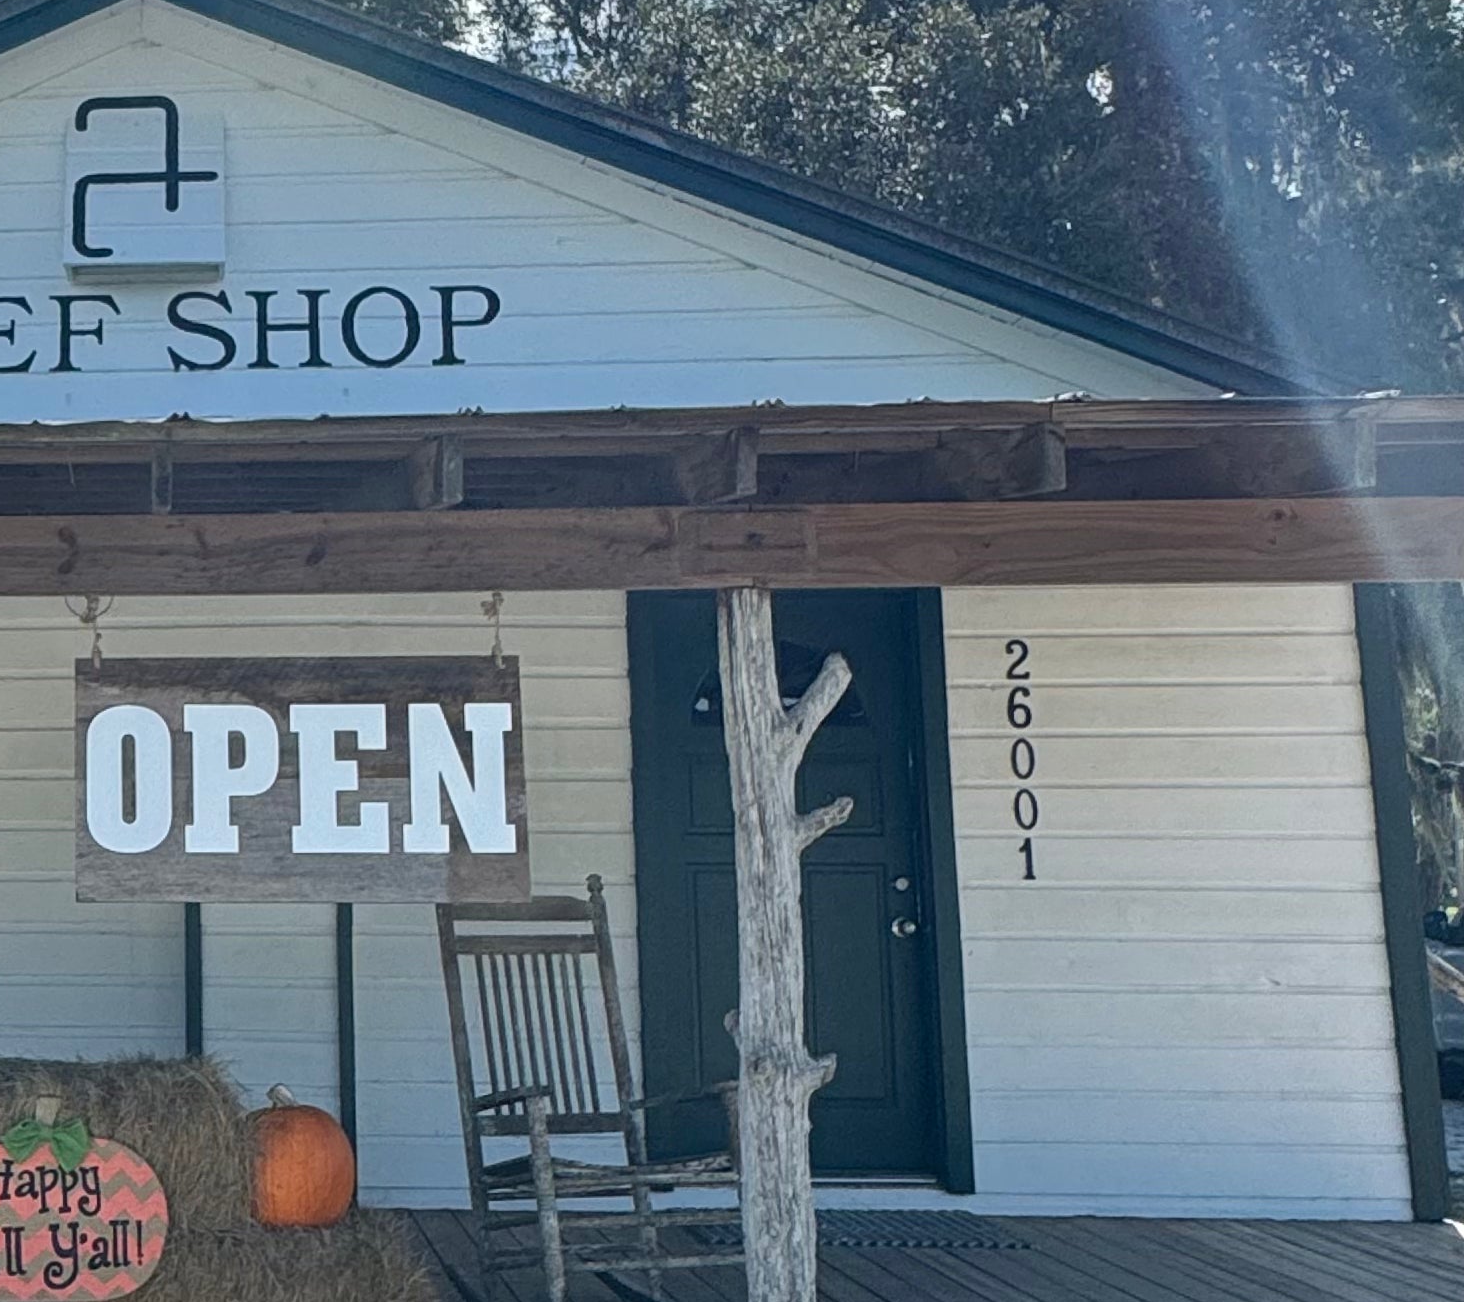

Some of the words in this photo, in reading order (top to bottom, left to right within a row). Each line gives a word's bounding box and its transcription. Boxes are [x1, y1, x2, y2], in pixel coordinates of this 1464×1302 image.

[166, 285, 502, 373] SHOP
[86, 702, 517, 854] OPEN
[1005, 639, 1039, 880] 26001
[43, 1219, 144, 1290] Y'all!
